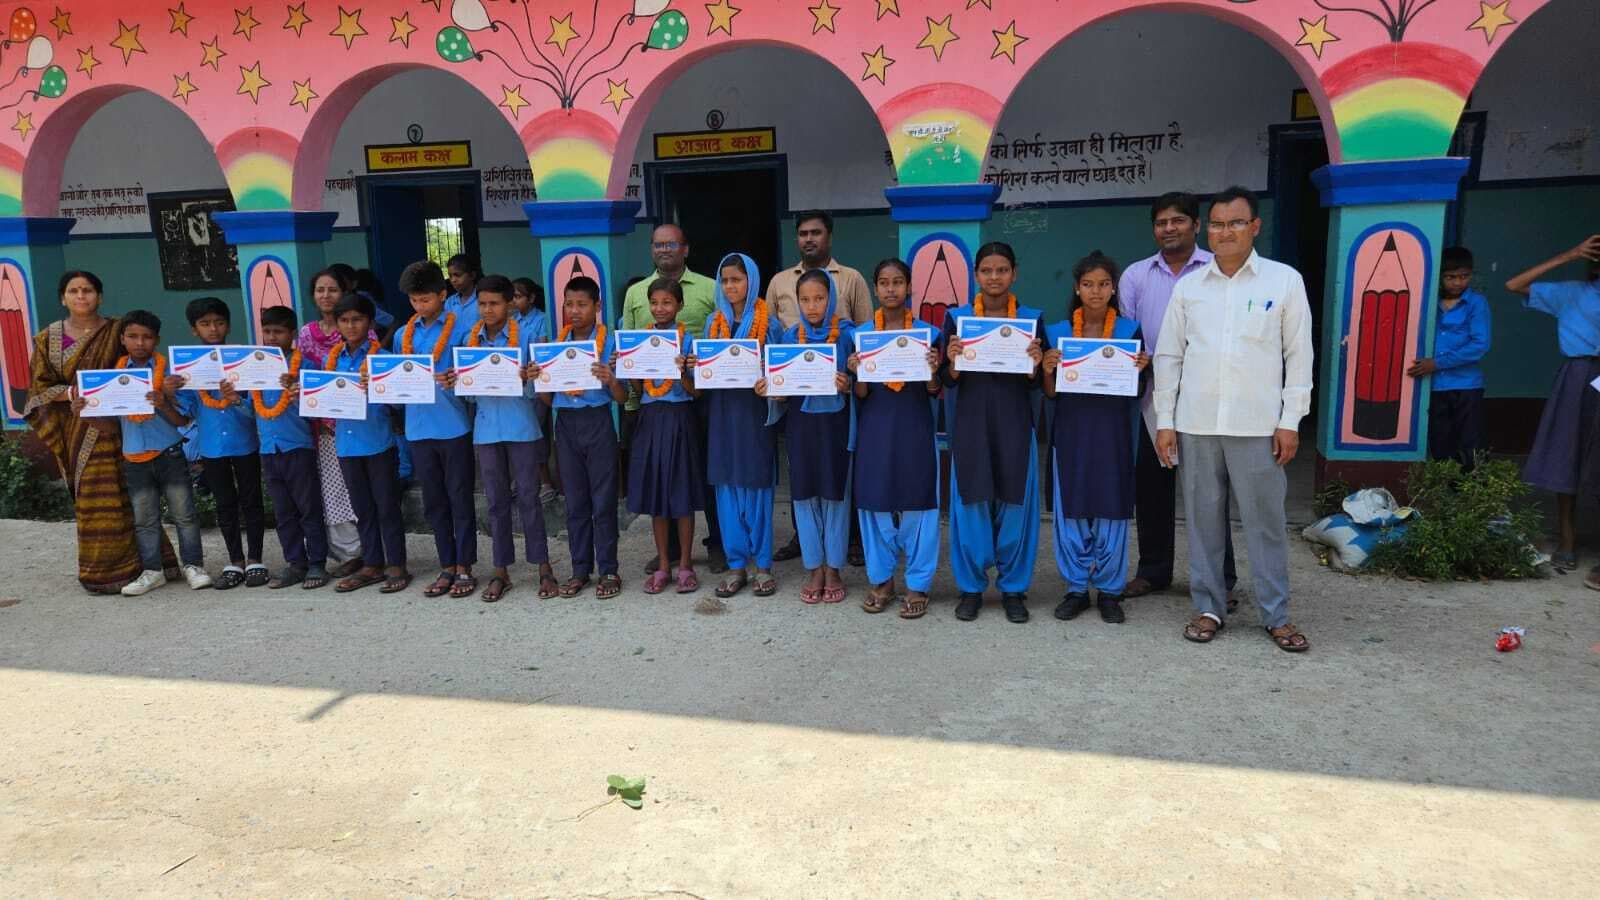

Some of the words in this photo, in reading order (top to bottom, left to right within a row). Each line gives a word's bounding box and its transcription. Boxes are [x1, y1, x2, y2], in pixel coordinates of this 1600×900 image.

[731, 135, 763, 149] कक्ष
[990, 132, 1008, 159] को
[1013, 132, 1045, 162] सिर्फ
[1048, 139, 1086, 159] उतना
[1089, 132, 1104, 158] ही
[1109, 131, 1165, 155] मिलता
[380, 150, 418, 165] कलाम
[423, 149, 453, 164] कक्ष
[1030, 162, 1062, 191] करने
[1062, 159, 1090, 186] वाले
